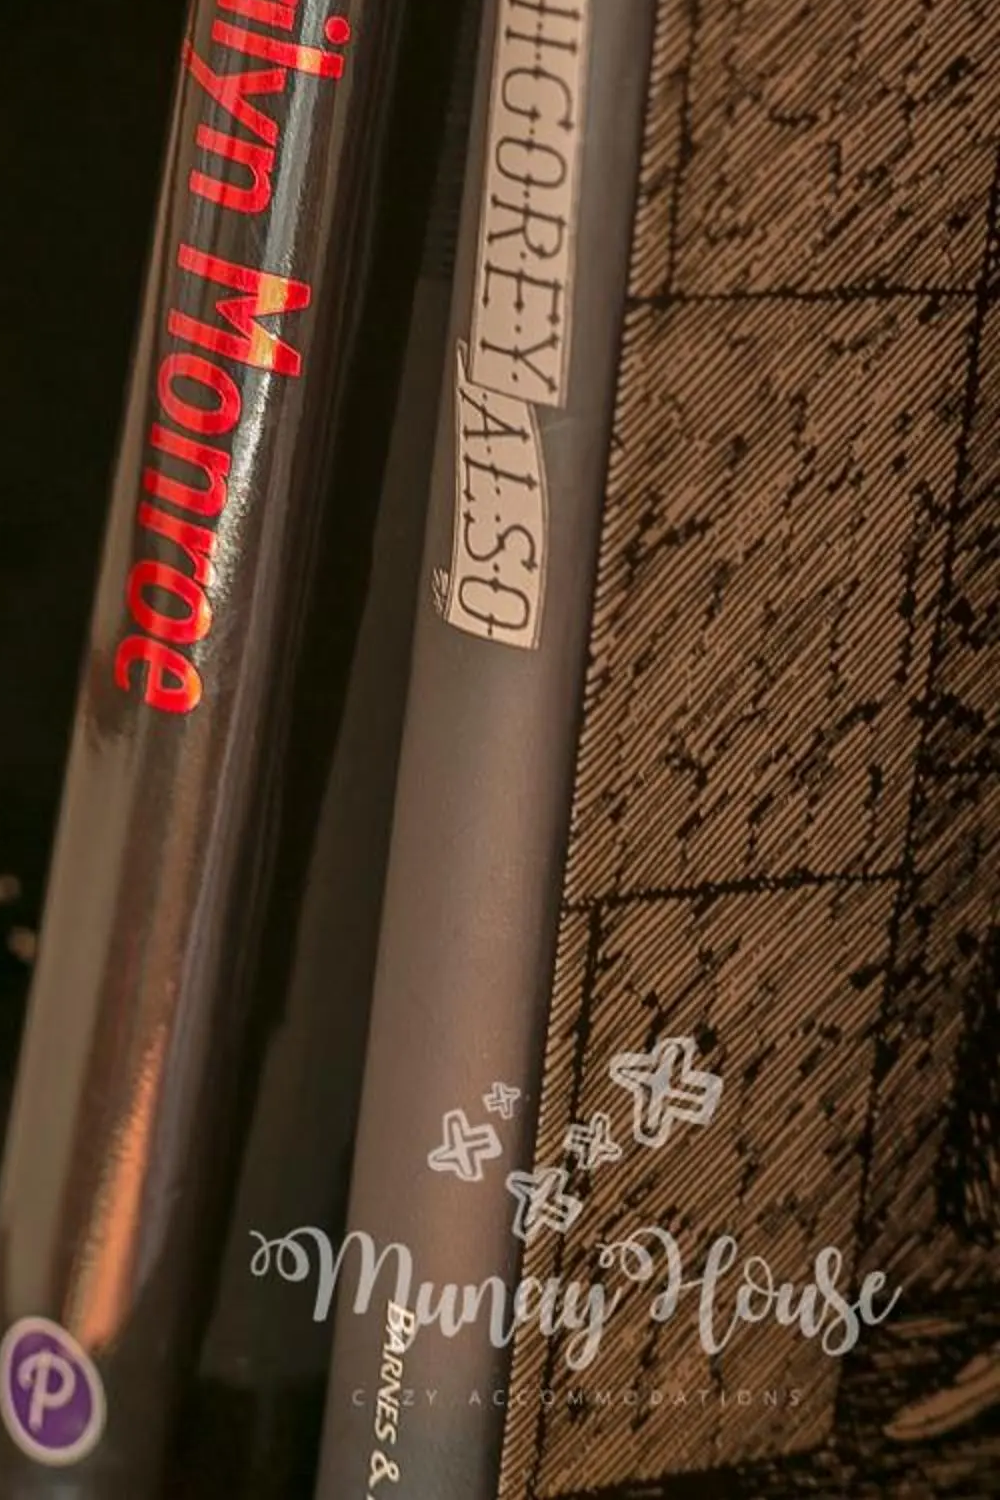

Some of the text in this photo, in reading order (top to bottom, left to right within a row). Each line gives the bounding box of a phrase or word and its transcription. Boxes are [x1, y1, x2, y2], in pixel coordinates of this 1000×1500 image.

[115, 243, 312, 715] Monroe
[457, 387, 540, 636] ALSO
[368, 1299, 415, 1489] BARNES &
